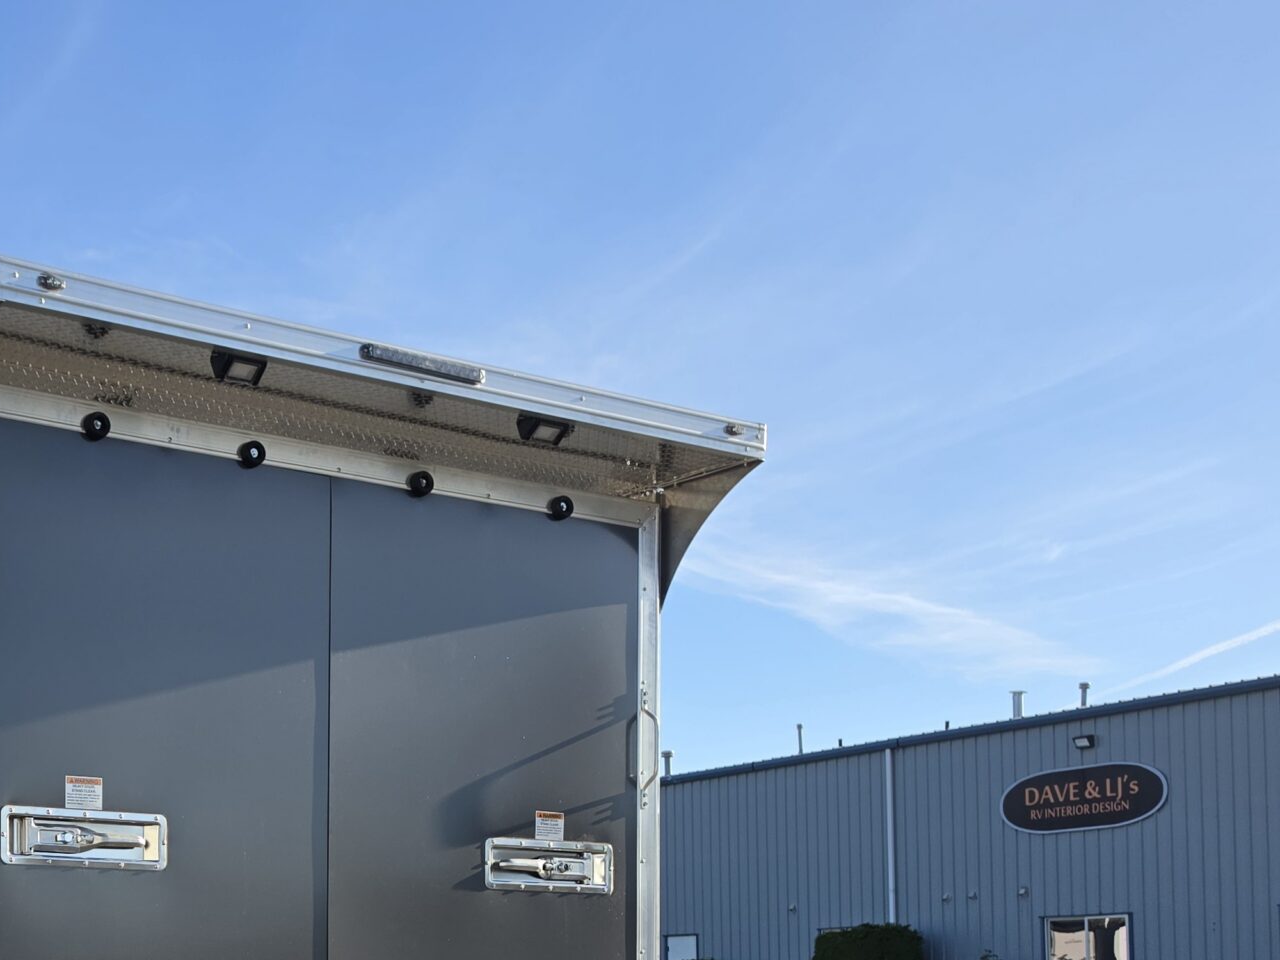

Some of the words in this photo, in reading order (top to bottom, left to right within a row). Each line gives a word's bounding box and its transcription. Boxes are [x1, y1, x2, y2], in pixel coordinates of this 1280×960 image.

[1024, 782, 1080, 806] DAVE
[1084, 780, 1102, 800] &
[1106, 774, 1139, 801] LJ's
[1030, 808, 1043, 820] RV
[1045, 804, 1090, 819] INTERIOR
[1092, 800, 1130, 814] DESIGN
